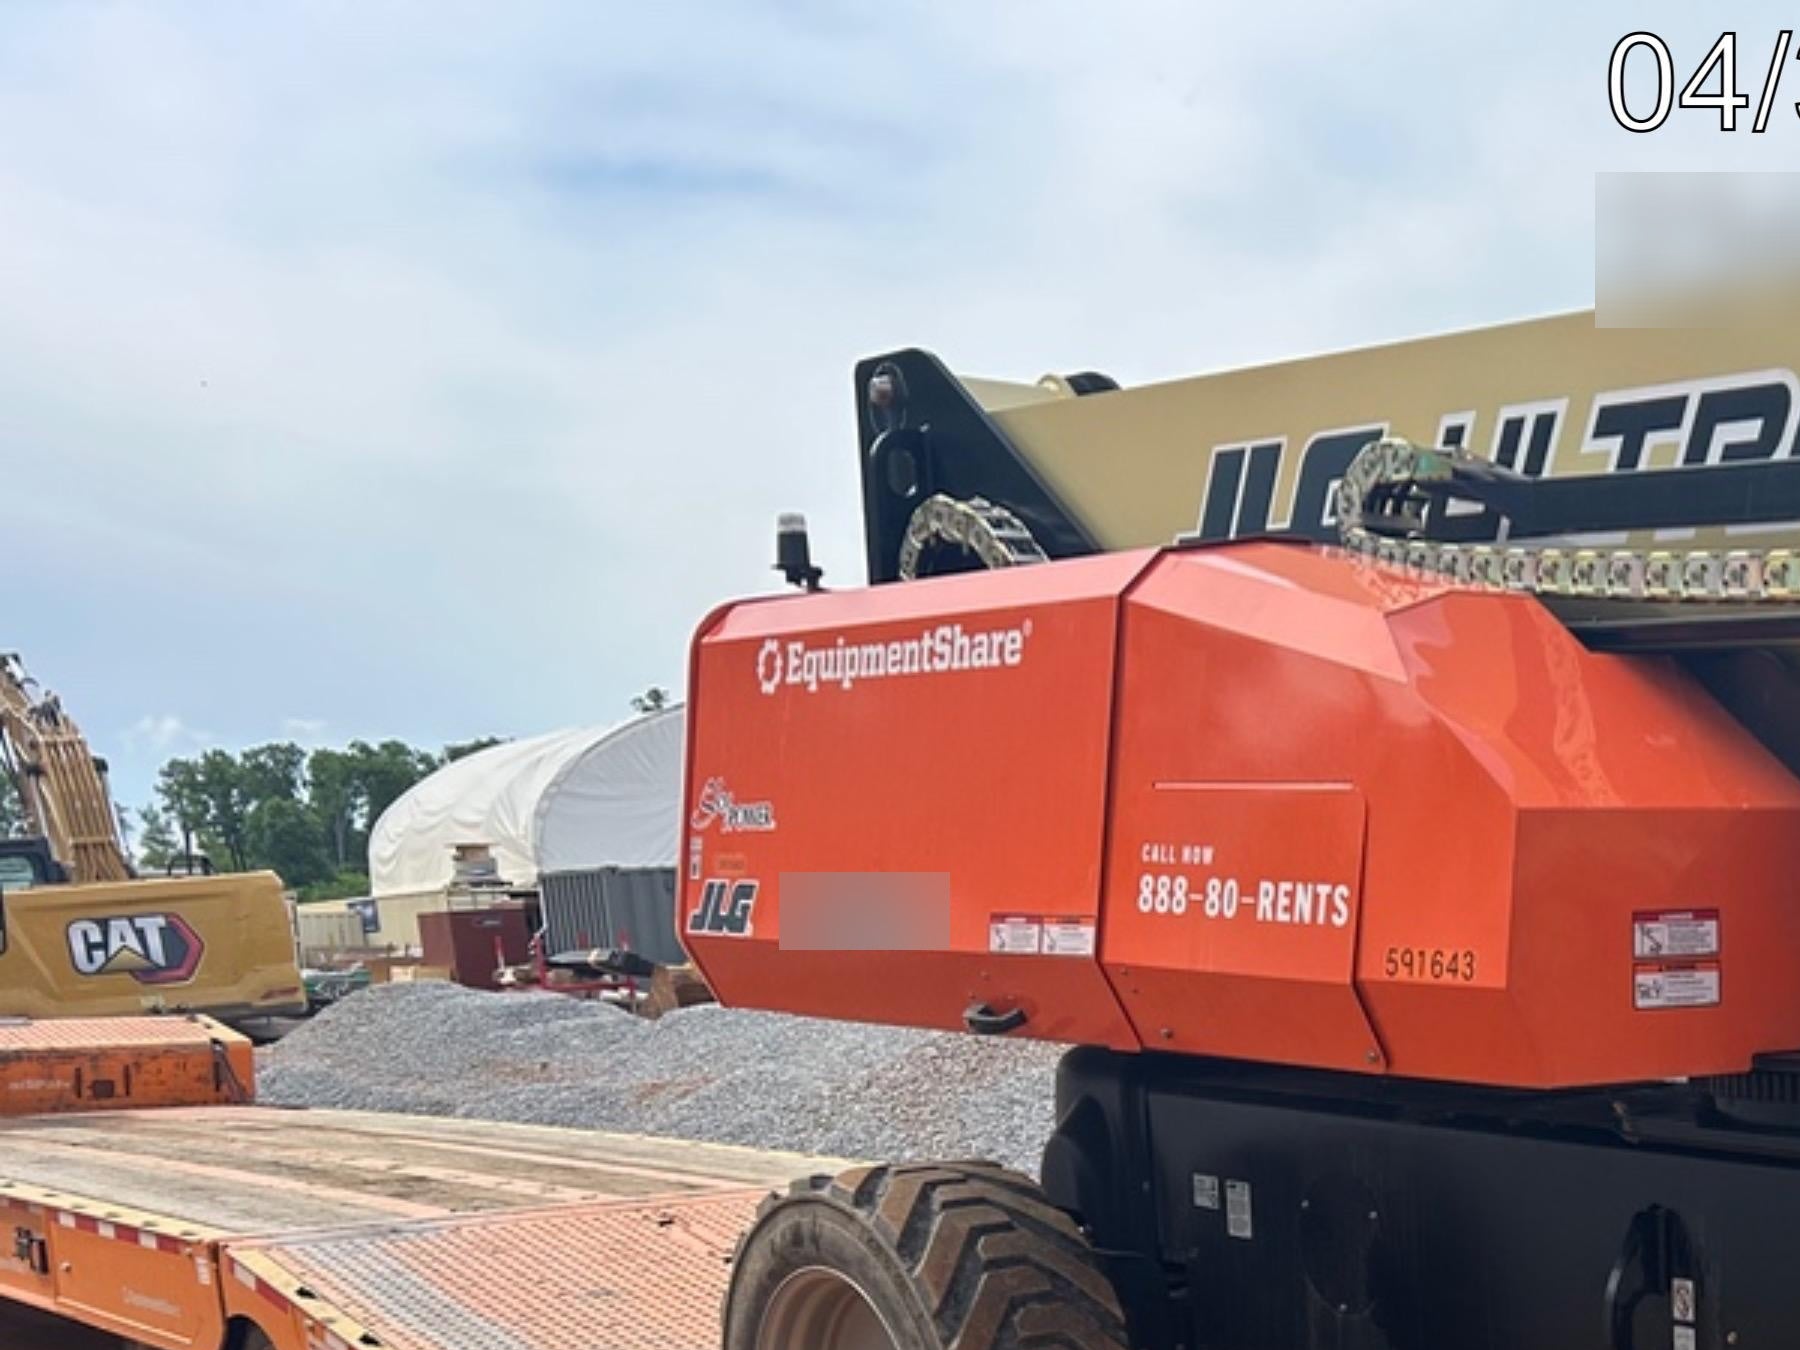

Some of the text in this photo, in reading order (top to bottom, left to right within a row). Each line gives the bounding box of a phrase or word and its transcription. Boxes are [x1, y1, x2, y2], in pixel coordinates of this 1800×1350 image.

[1142, 843, 1215, 866] CALL NOW
[687, 878, 760, 937] JLG
[1137, 873, 1351, 928] 888-80-RENTS
[68, 915, 167, 974] CAT
[1384, 947, 1476, 981] 591643
